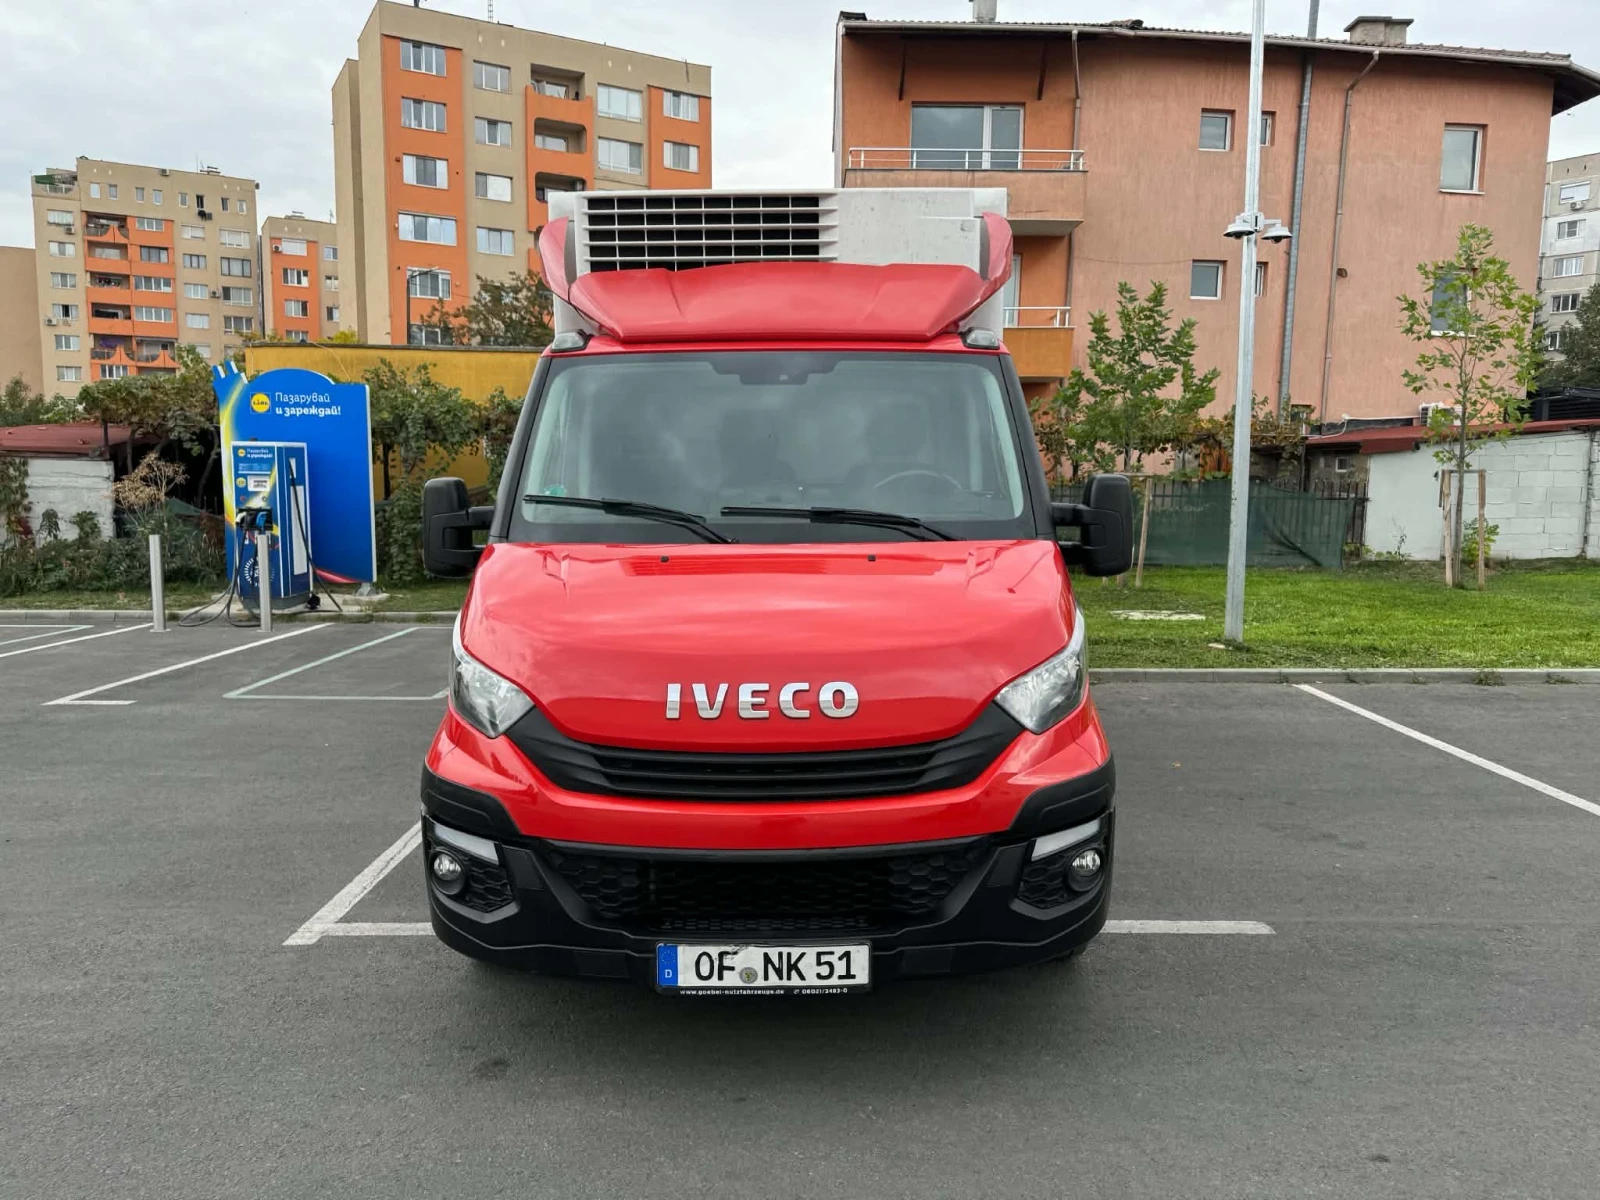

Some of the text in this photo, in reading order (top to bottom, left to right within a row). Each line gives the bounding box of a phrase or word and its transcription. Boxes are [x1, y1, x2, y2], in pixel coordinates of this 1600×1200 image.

[275, 392, 330, 404] Пазарувай
[275, 405, 341, 417] и зареждай!
[666, 681, 860, 719] IVECO
[695, 950, 856, 981] OF NK 51
[664, 969, 673, 979] D
[679, 988, 785, 996] www.goebel-nutzfahrzeuge.de
